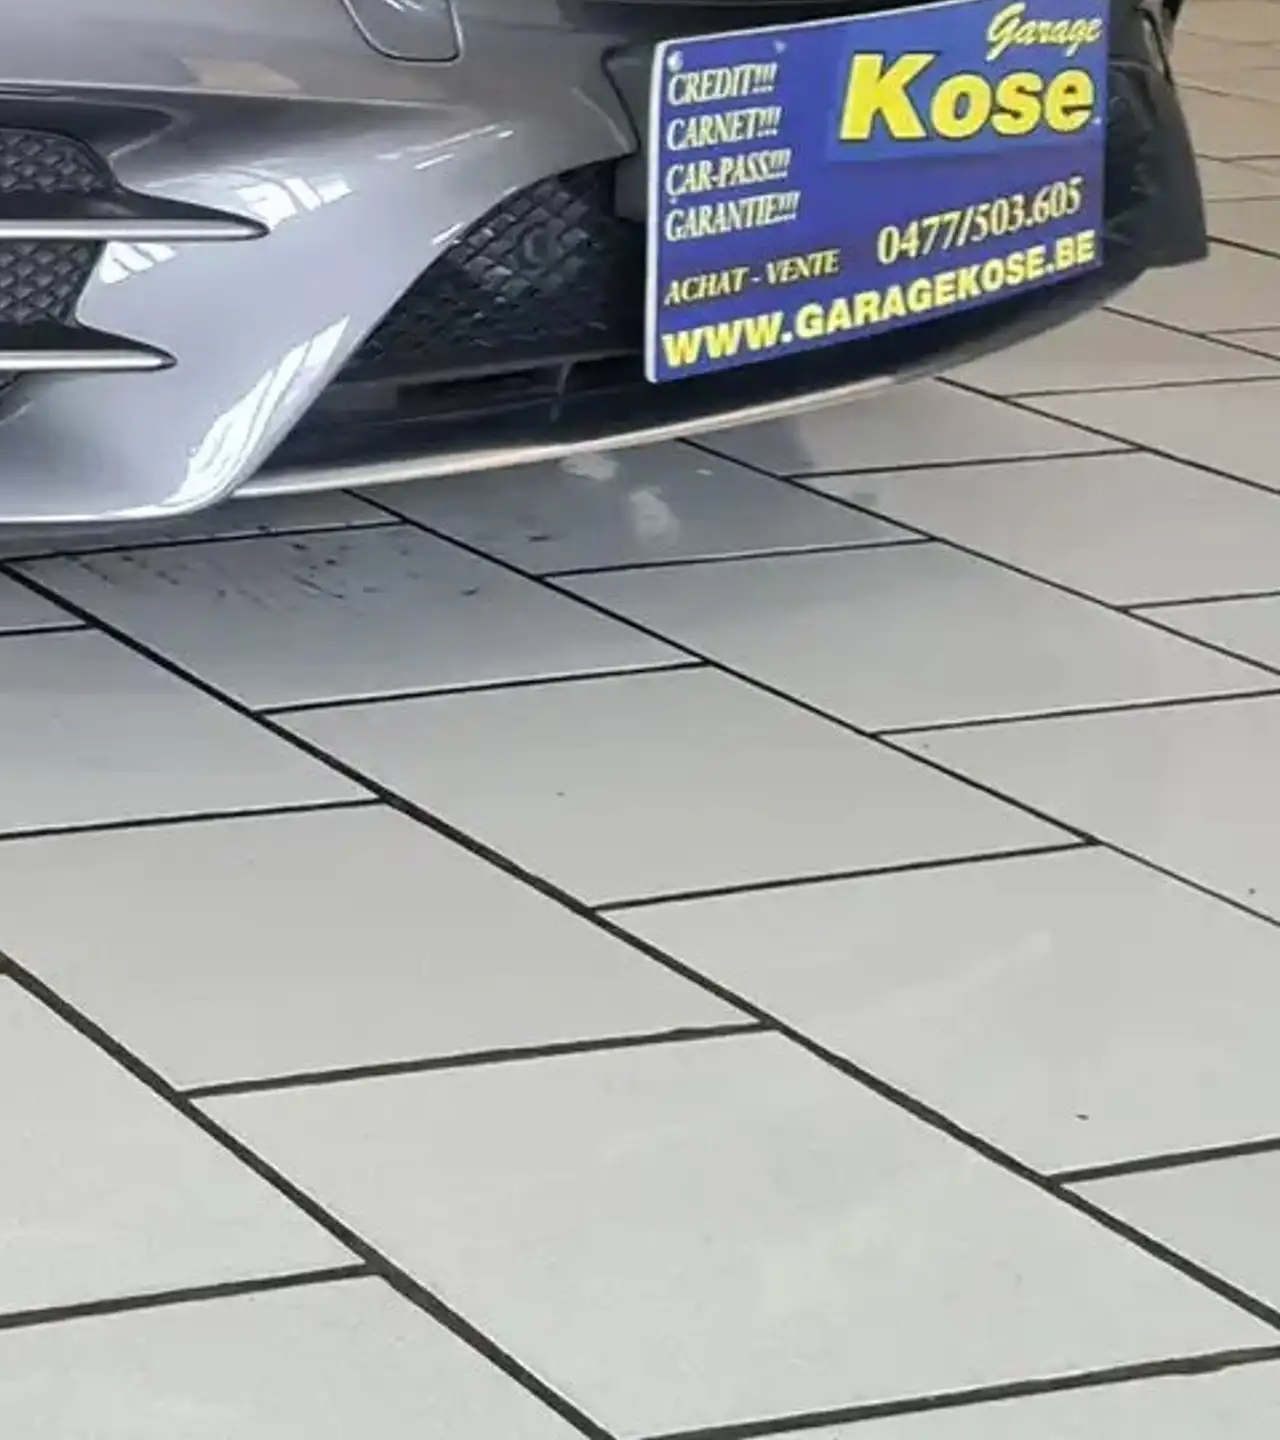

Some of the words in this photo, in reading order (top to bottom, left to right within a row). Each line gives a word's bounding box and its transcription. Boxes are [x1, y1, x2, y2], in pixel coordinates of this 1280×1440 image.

[986, 1, 1102, 61] Garage
[668, 62, 778, 106] CREDIT!!!
[839, 53, 1095, 140] Kose
[666, 106, 782, 151] CARNET!!!
[664, 147, 791, 197] CAR-PASS!!!
[664, 190, 801, 242] GARANTIE!!!
[877, 176, 1083, 264] 0477/503.605
[661, 229, 1096, 367] WWW.GARAGEKOSE.BE
[664, 266, 749, 306] ACHAT
[765, 248, 840, 285] VENTE
